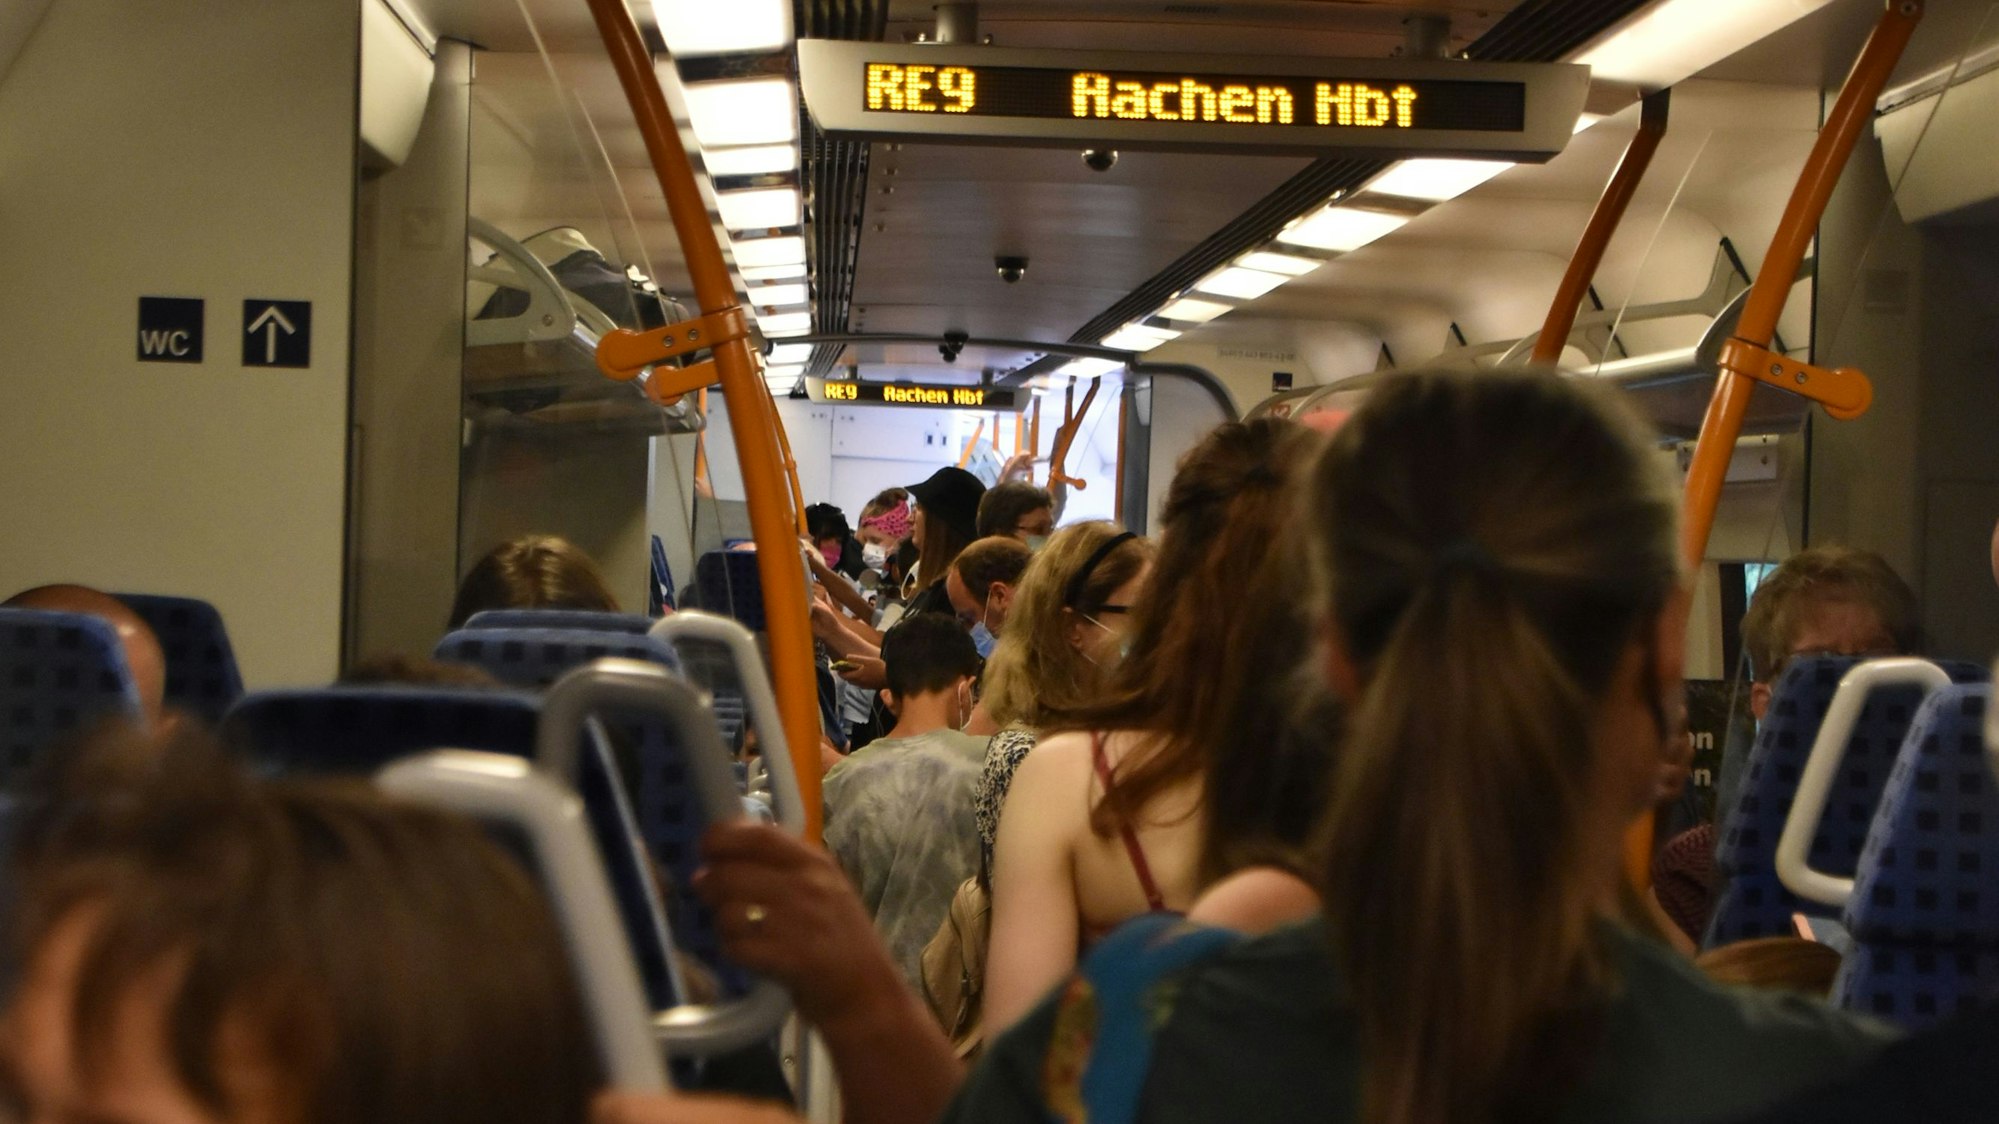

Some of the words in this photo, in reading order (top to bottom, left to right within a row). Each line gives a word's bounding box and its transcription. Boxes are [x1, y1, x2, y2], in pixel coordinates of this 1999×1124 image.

[868, 64, 975, 113] RE9
[1073, 73, 1293, 124] Aachen
[141, 330, 189, 356] WC
[825, 383, 857, 399] RE9
[883, 386, 948, 404] Aachen
[953, 389, 983, 405] Hbf
